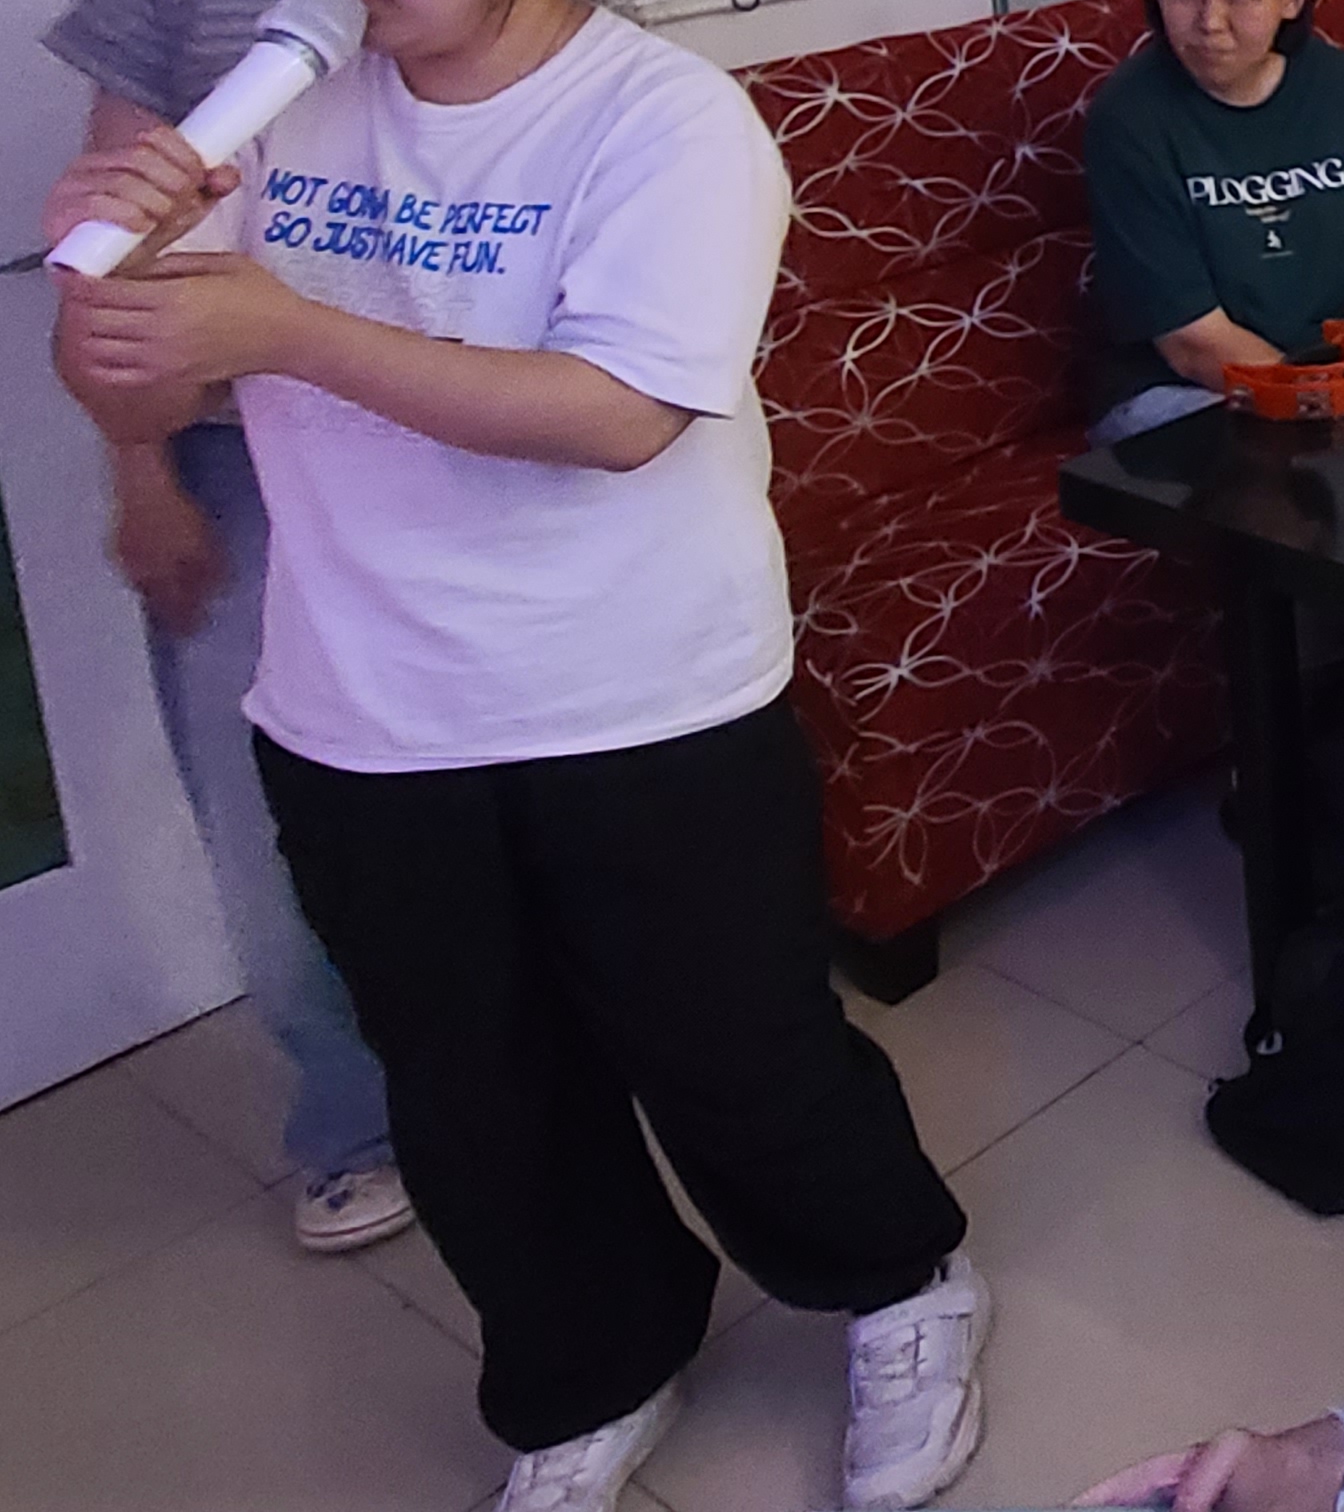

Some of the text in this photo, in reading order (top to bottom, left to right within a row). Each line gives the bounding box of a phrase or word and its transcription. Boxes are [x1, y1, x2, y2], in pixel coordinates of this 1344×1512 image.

[261, 168, 328, 206] NOT
[395, 194, 440, 230] BE
[440, 202, 551, 236] PERFECT
[264, 211, 312, 248] SO
[313, 222, 381, 261] JUST
[449, 241, 506, 274] FUN.
